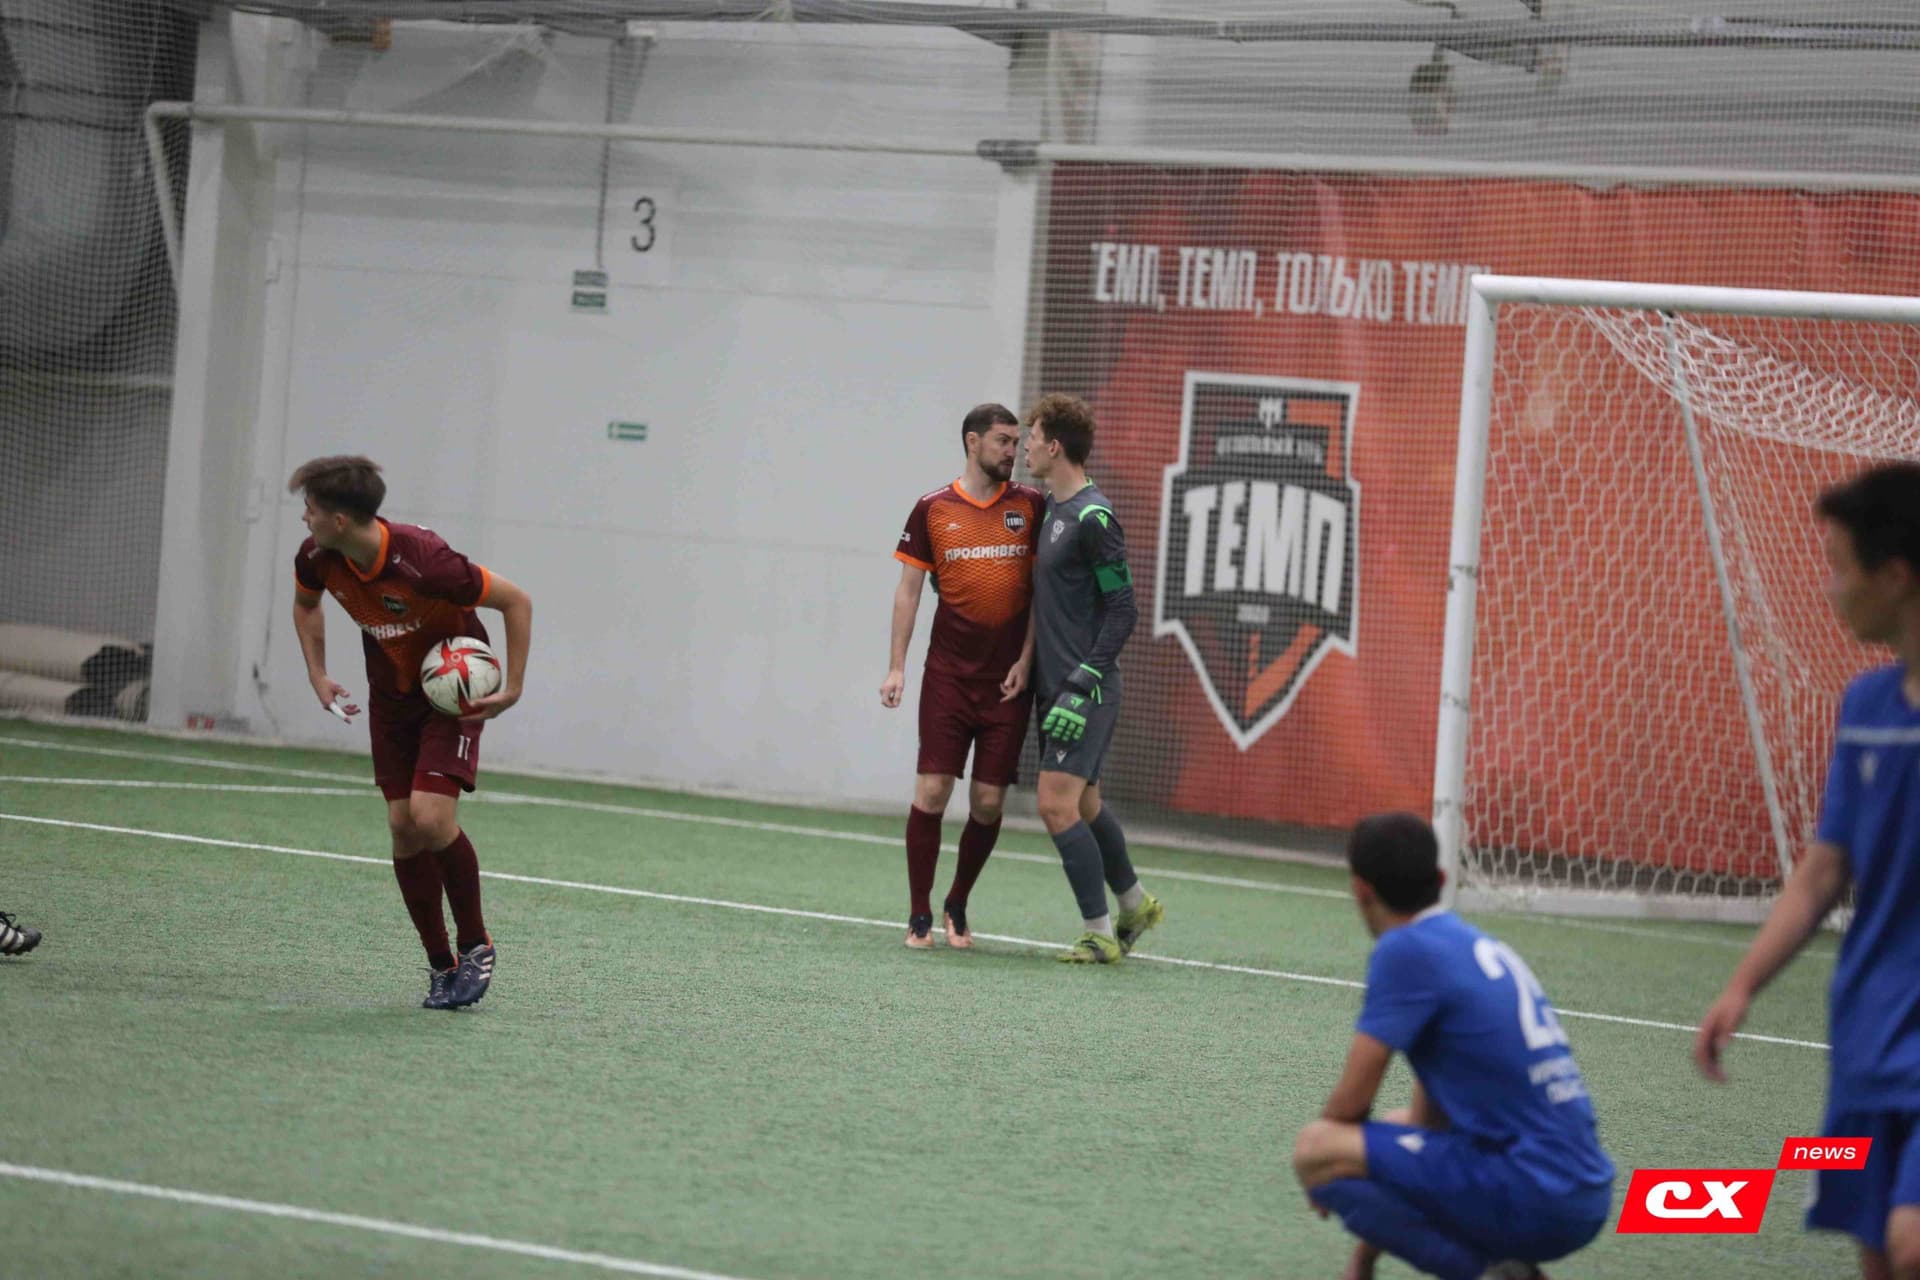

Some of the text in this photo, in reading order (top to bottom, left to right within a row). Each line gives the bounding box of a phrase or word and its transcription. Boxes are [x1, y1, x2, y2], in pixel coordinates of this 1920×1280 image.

[631, 197, 656, 252] 3
[1091, 242, 1491, 325] ЕМП, ТЕМП, ТОЛЬКО ТЕМП
[1184, 481, 1346, 614] ТЕМП
